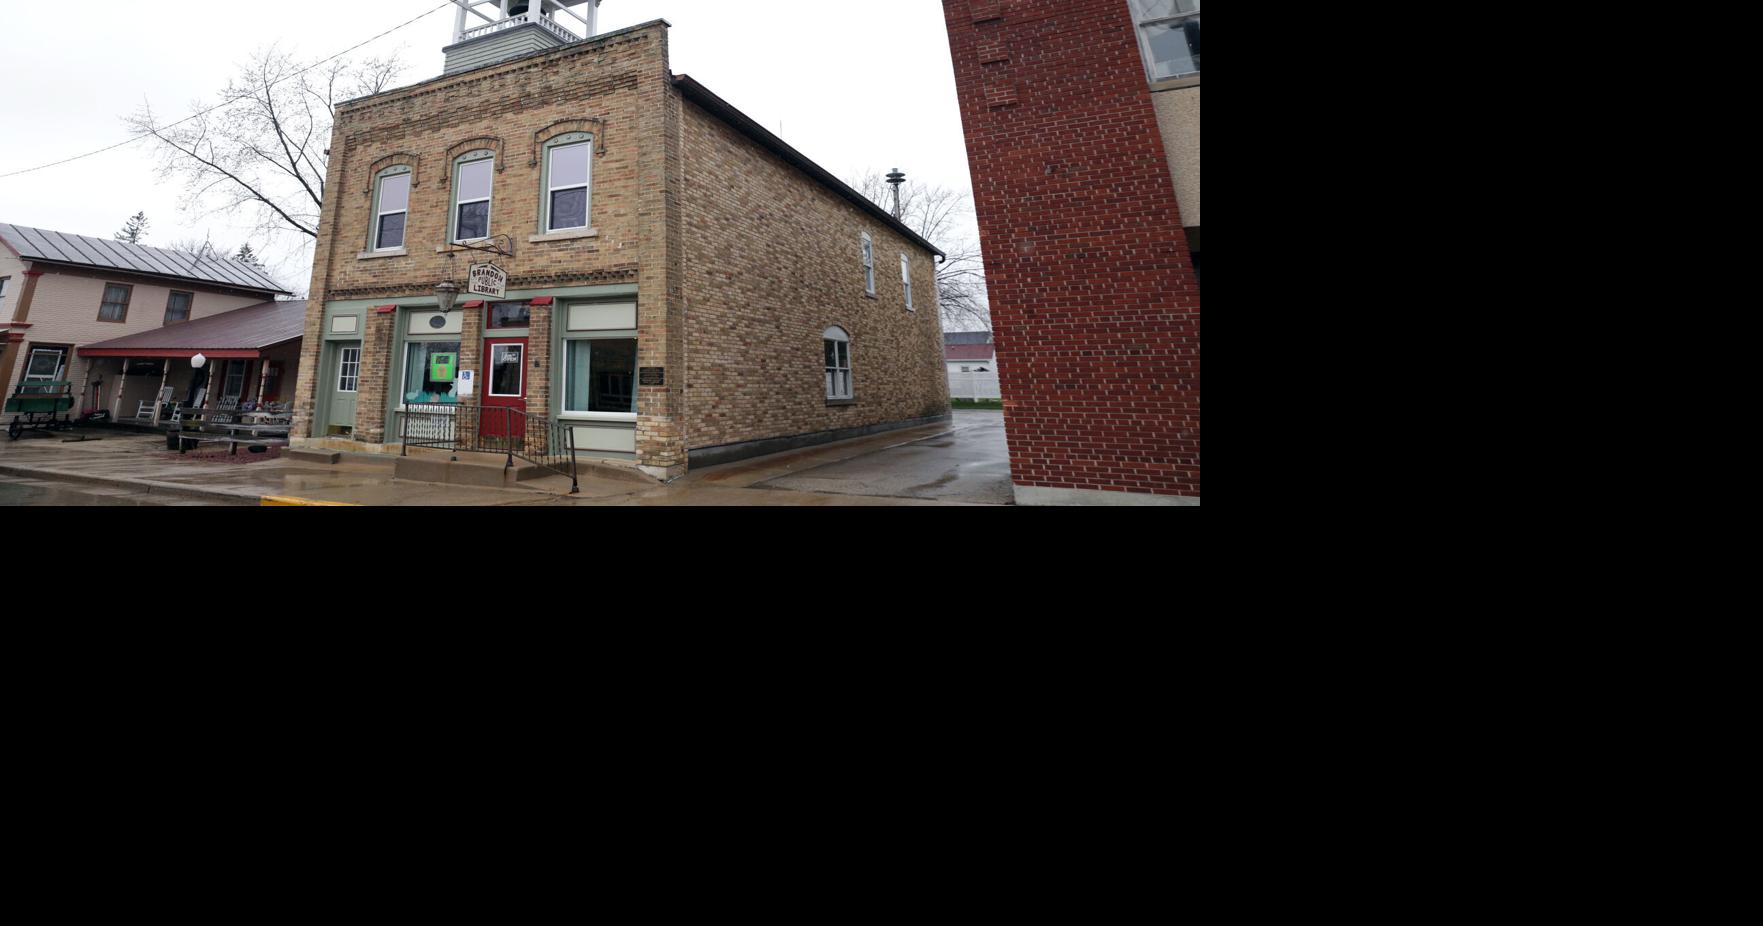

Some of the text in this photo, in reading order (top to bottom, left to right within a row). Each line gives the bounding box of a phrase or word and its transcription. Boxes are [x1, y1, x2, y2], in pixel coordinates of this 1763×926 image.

[472, 269, 503, 283] BRANDON
[478, 276, 497, 287] PUBLIC
[473, 284, 500, 296] LIBRARY
